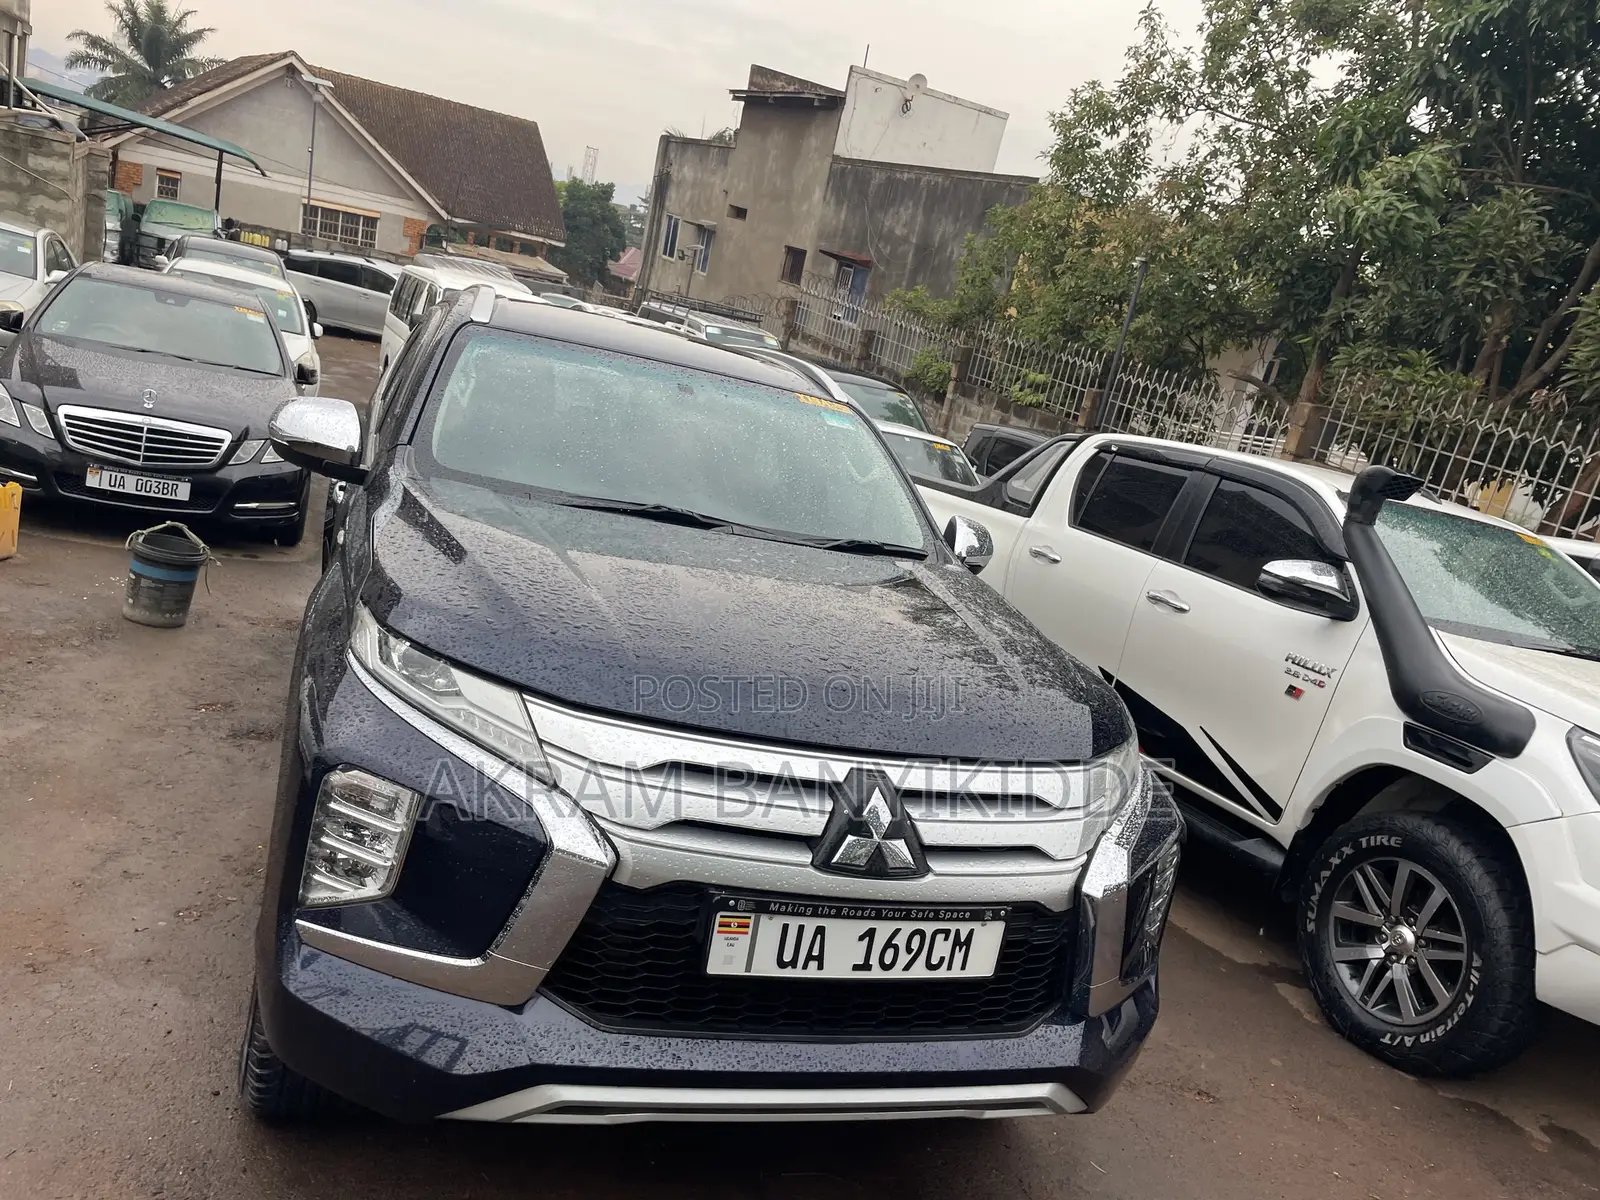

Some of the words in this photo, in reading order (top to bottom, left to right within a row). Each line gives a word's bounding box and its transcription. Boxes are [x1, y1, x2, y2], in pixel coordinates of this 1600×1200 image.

[108, 473, 125, 490] UA
[135, 478, 179, 498] 003BR
[1284, 651, 1338, 680] HILUX
[1359, 834, 1403, 849] TIRE
[769, 902, 813, 916] Making
[818, 905, 837, 916] the
[841, 907, 877, 918] Roads
[881, 908, 907, 919] Your
[910, 909, 935, 920] Safe
[938, 909, 971, 920] Space
[776, 922, 827, 971] UA
[851, 926, 976, 972] 169CM
[1420, 951, 1482, 1044] All-Terrain
[1379, 1032, 1417, 1048] A/T
